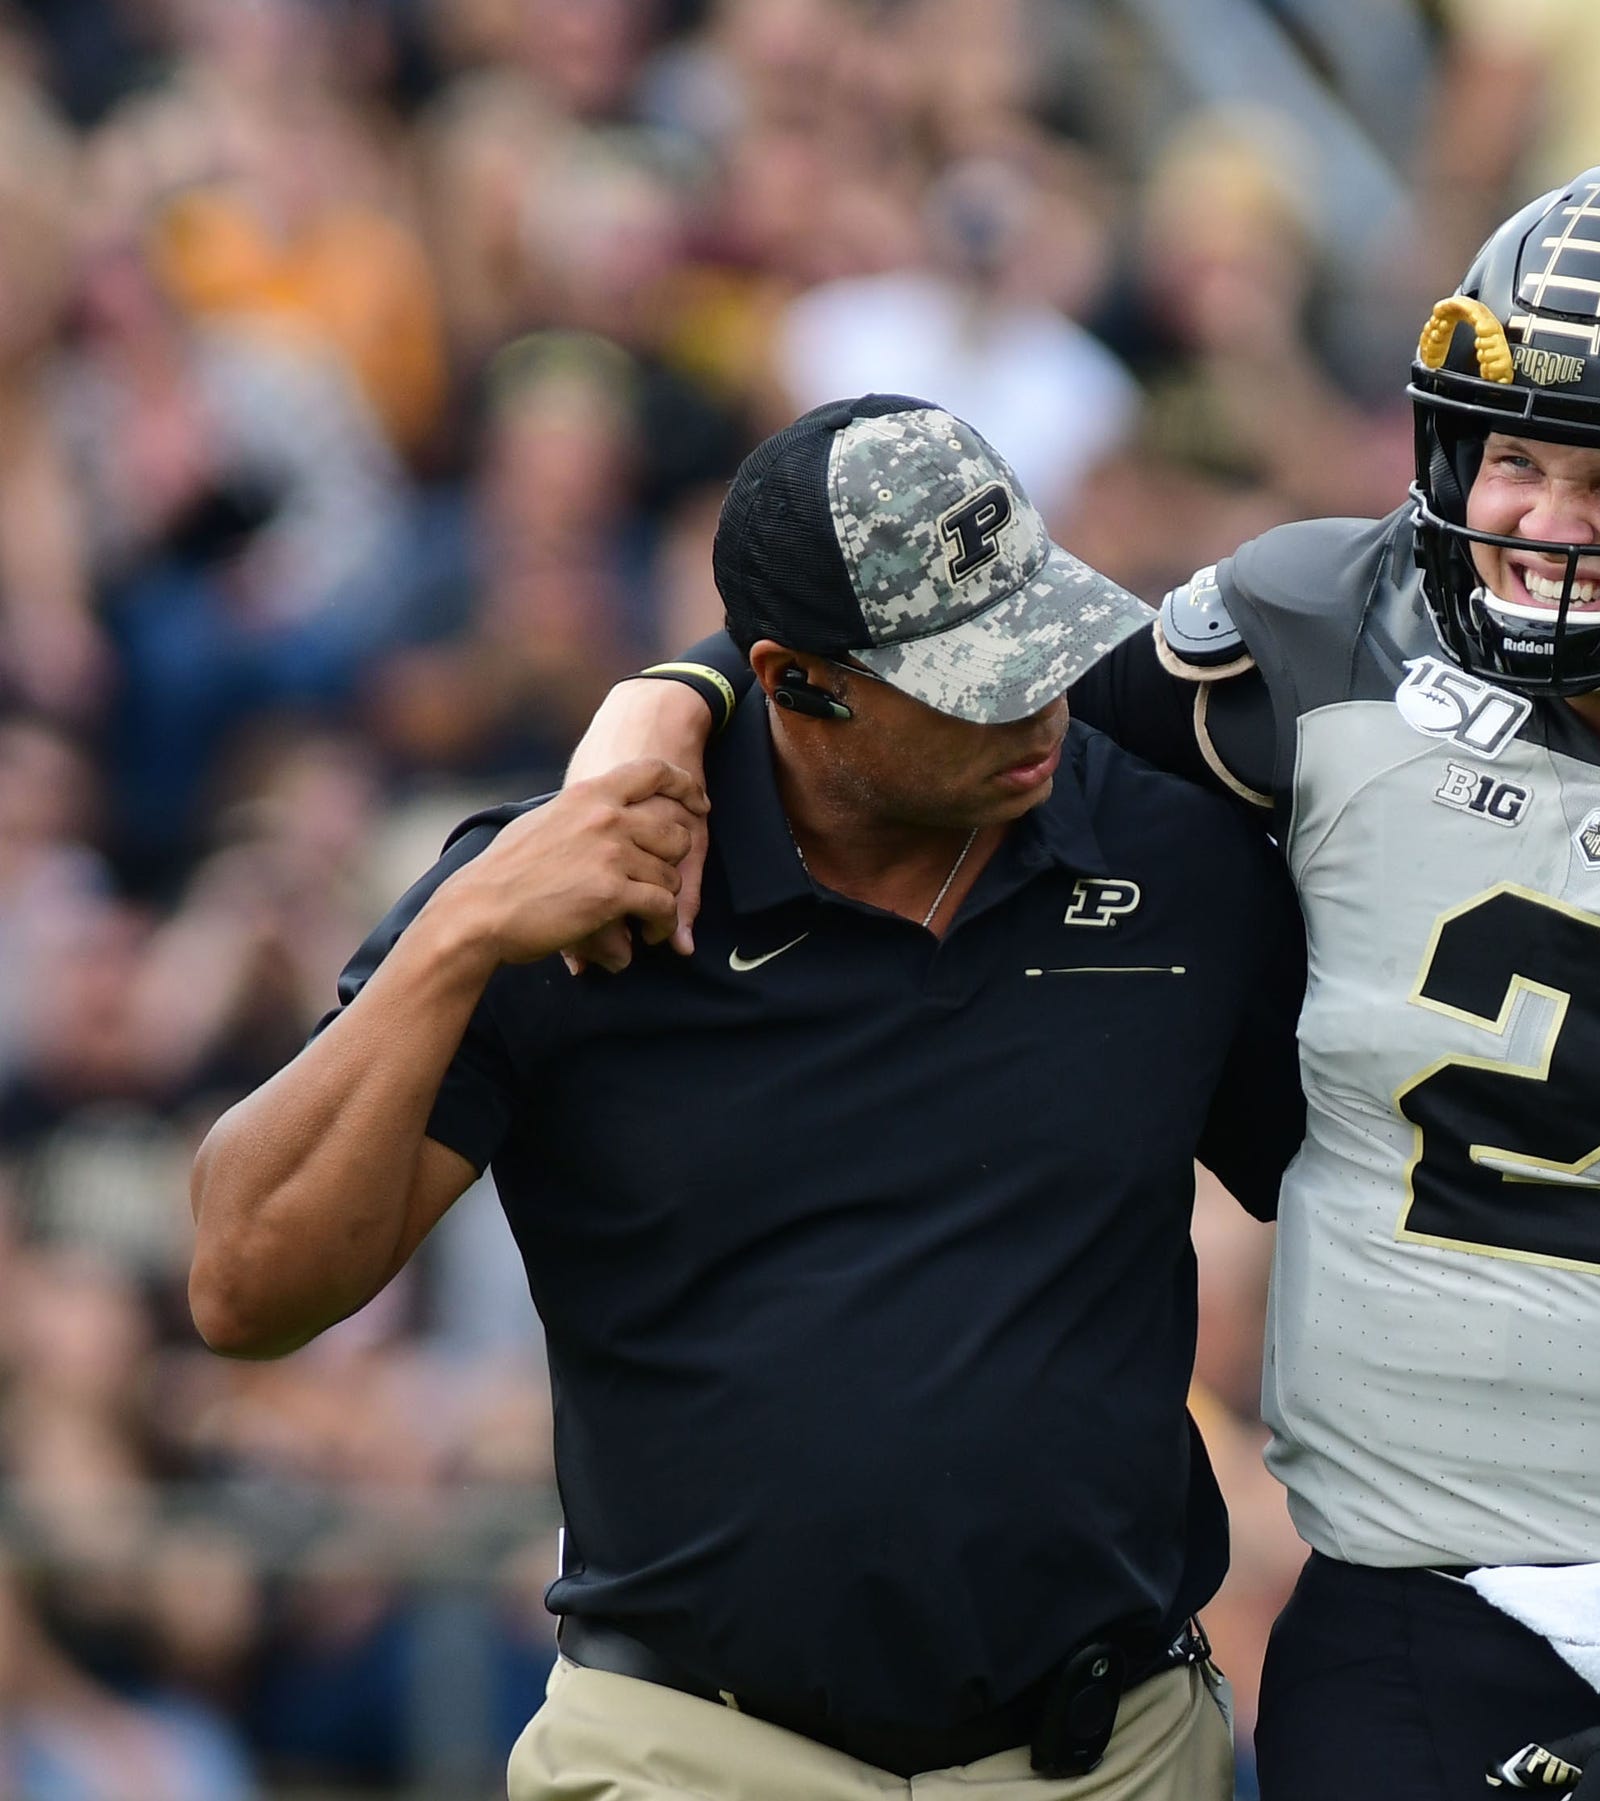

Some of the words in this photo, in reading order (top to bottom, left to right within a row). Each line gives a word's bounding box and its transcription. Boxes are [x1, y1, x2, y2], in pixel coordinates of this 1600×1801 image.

[1513, 346, 1585, 386] PURDUE
[936, 480, 1013, 589] P
[1503, 637, 1555, 655] Riddell
[1405, 659, 1528, 755] 150
[1064, 878, 1141, 927] P
